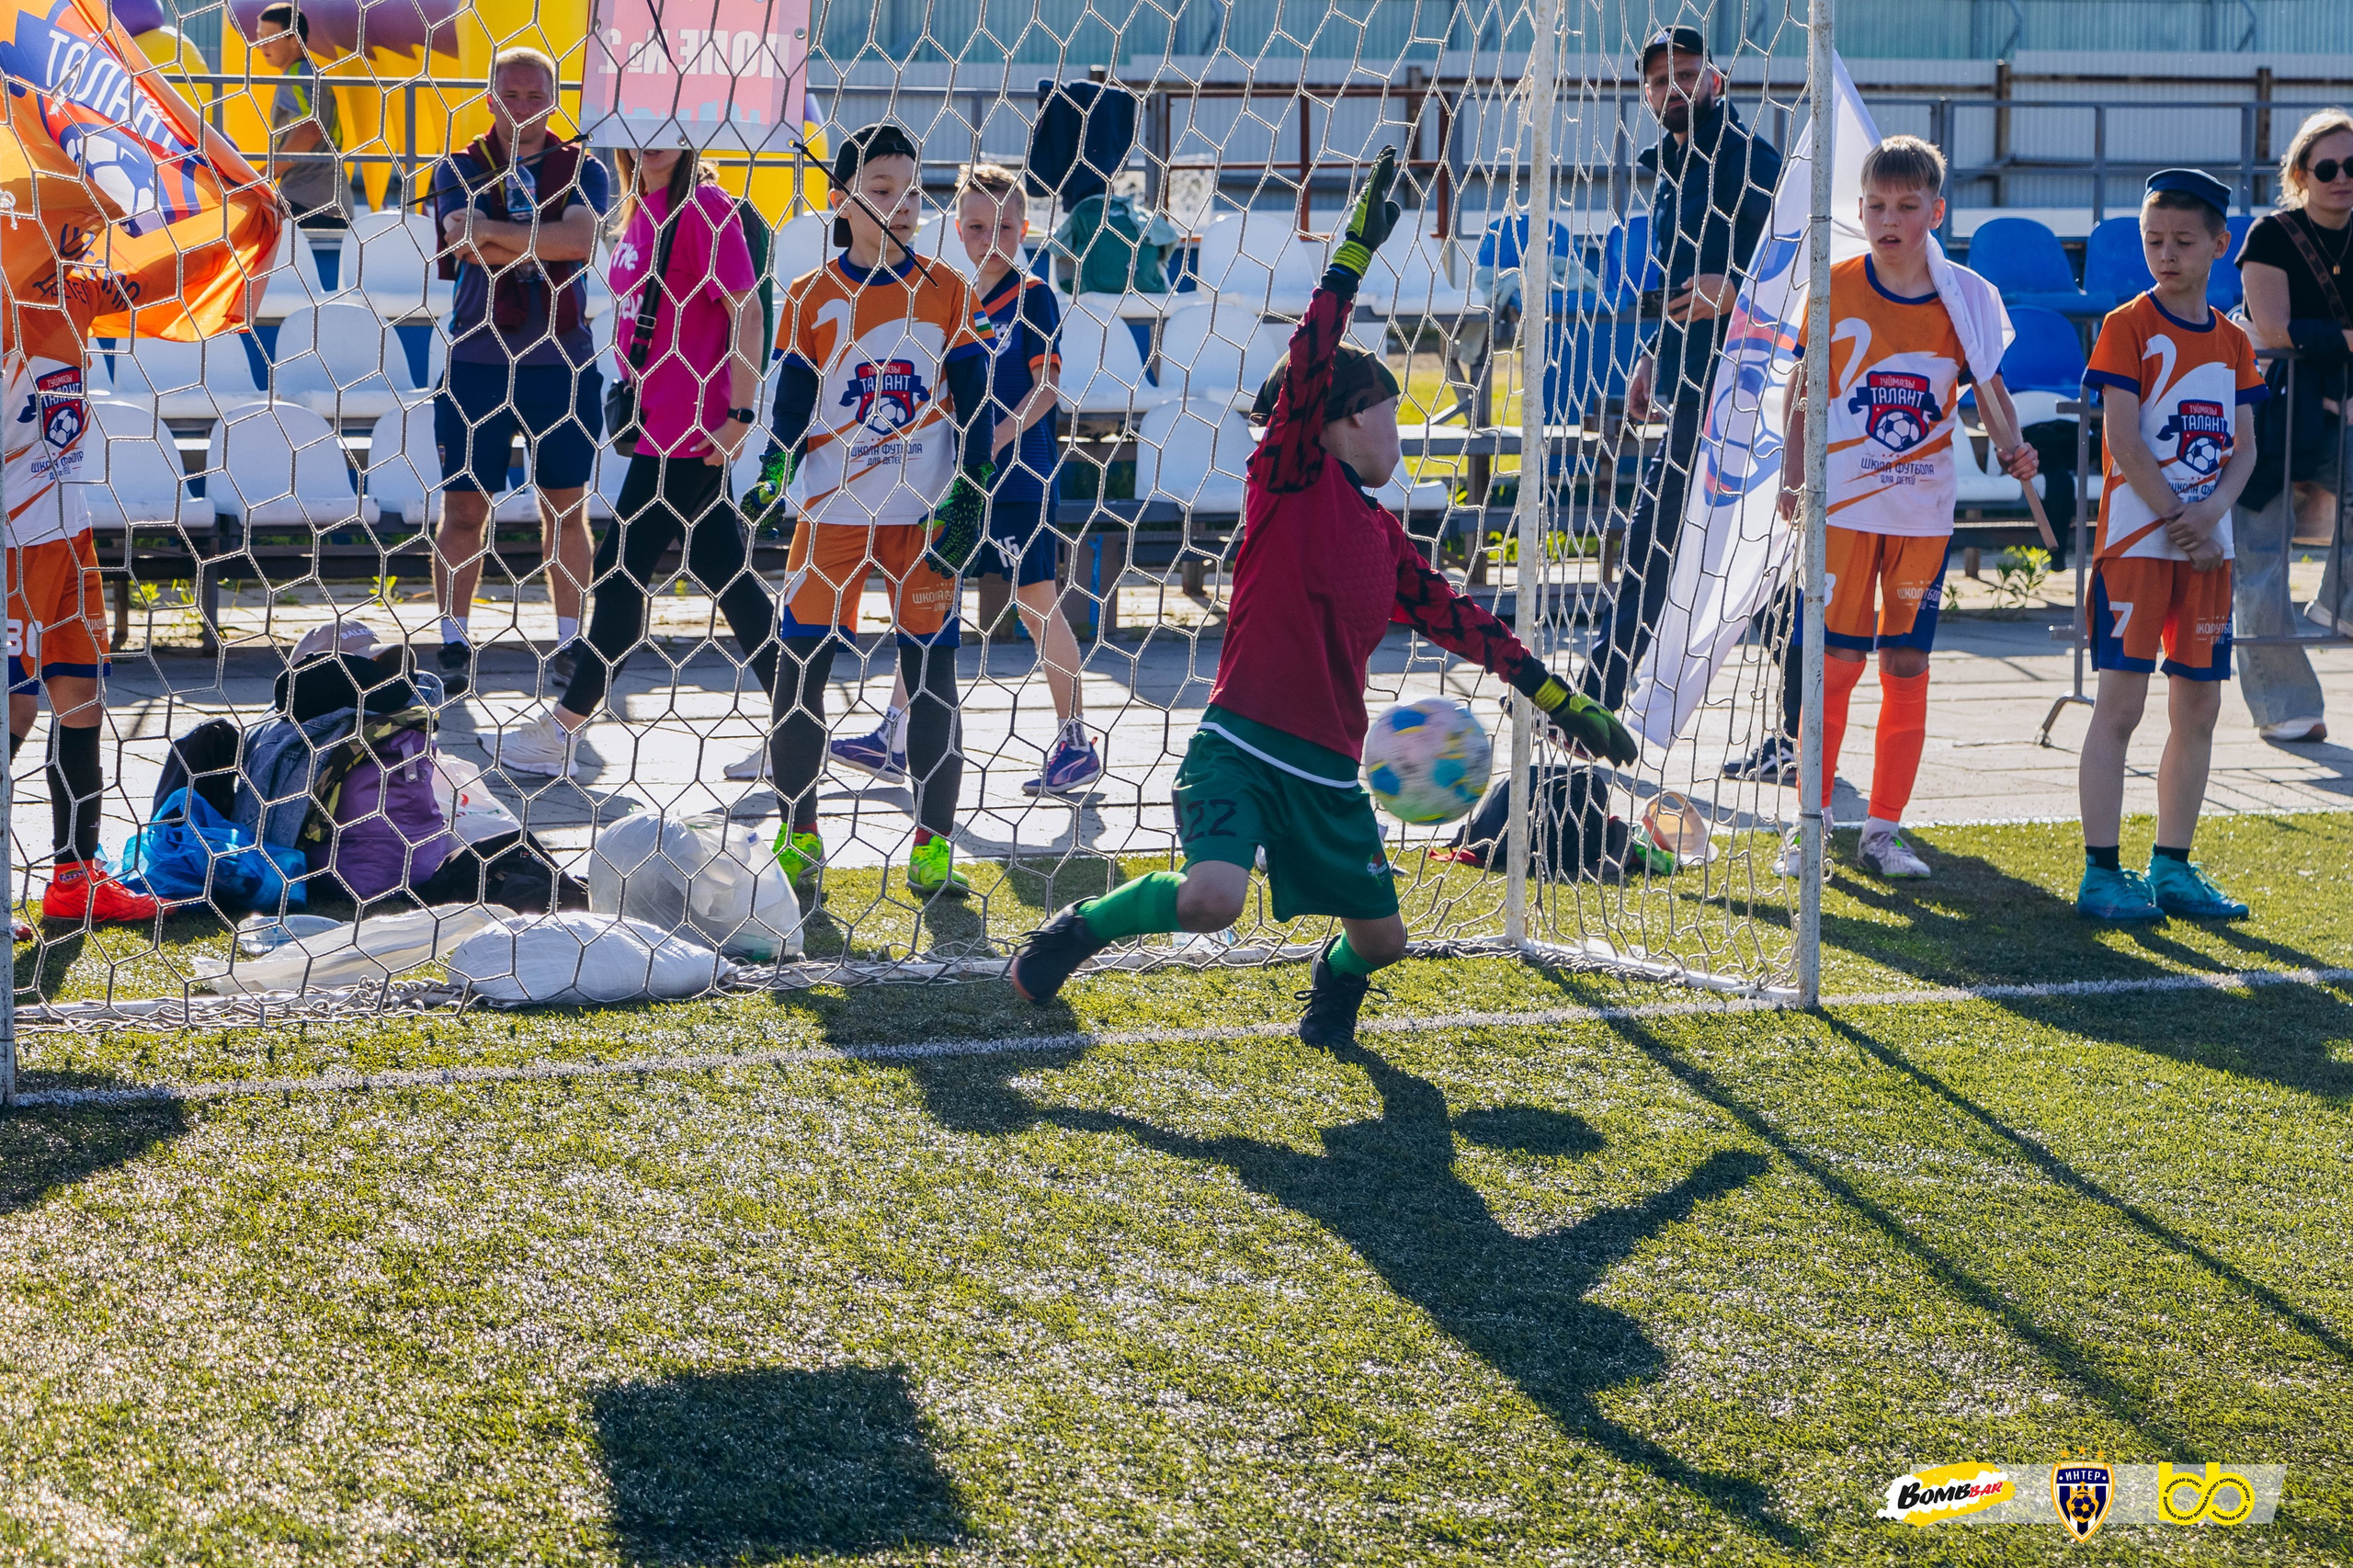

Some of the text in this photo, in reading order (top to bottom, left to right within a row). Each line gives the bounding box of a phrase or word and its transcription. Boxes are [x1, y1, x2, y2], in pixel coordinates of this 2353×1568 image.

[867, 365, 901, 375] ТУАЗЫ
[859, 374, 911, 393] ТААНТ
[1870, 387, 1925, 407] ТАЛАНТ
[2181, 415, 2224, 432] ТАЛАНТ
[881, 443, 923, 455] ФУТОЛА
[2109, 601, 2133, 638] 7
[1184, 799, 1237, 843] 22
